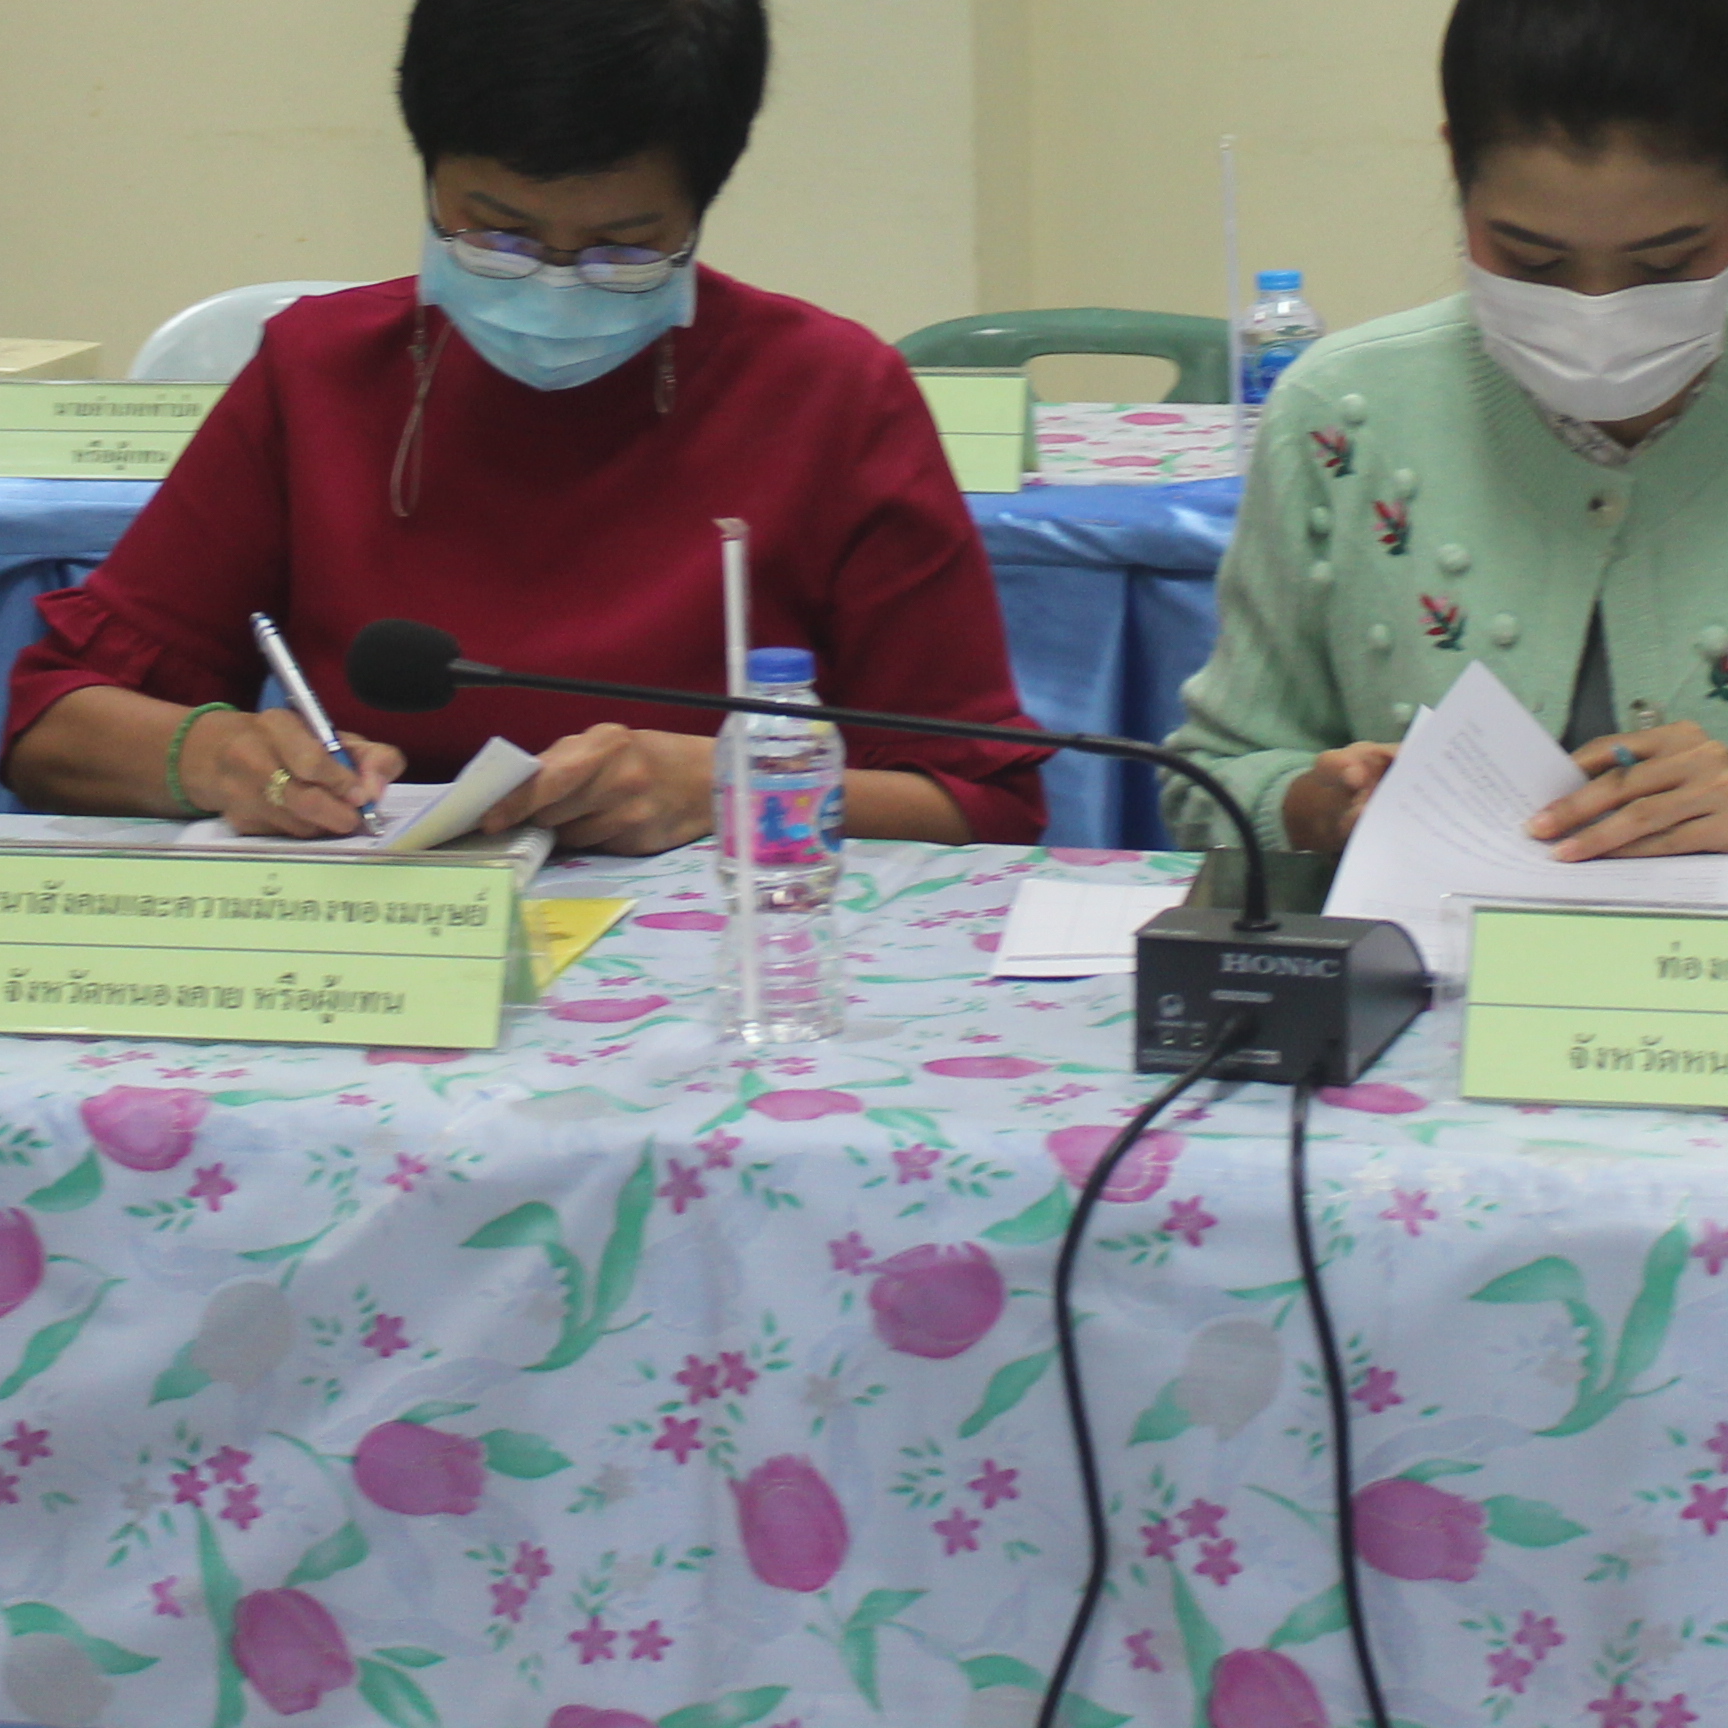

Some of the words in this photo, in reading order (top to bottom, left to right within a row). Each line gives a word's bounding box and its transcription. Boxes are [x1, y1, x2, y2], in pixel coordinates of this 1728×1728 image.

[2, 968, 244, 1009] จังหวัดหนองคาย
[252, 972, 405, 1024] หรือผู้แทน
